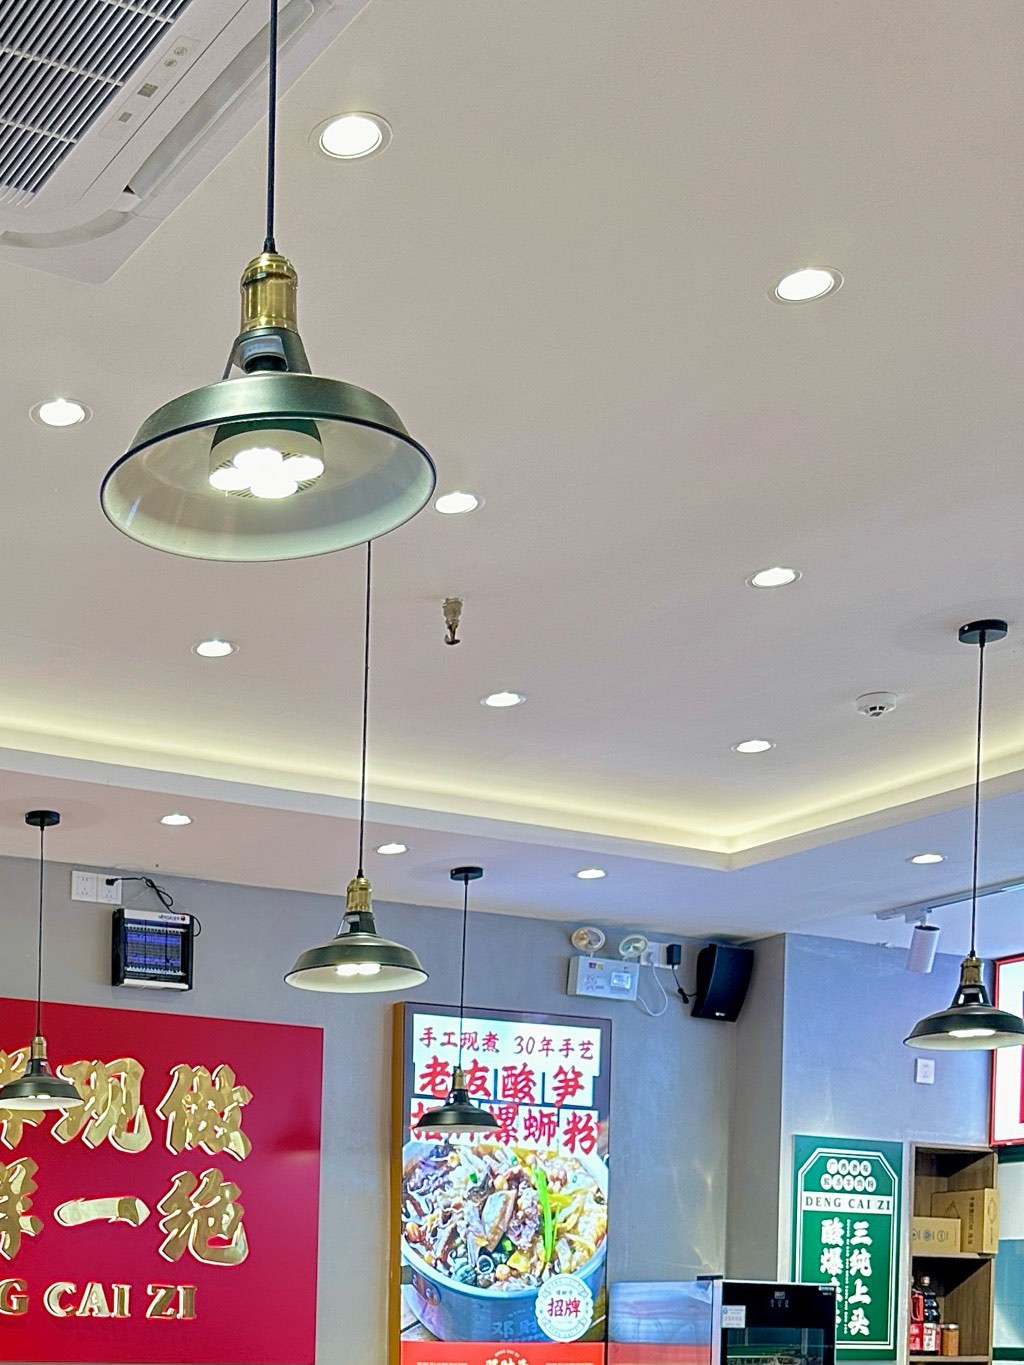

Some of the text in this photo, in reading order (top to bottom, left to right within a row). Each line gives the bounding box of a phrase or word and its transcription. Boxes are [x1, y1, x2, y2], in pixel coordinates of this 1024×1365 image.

[419, 1027, 594, 1060] 手工现煮 30年手艺
[419, 1055, 585, 1107] 老友酸笋
[805, 1196, 890, 1210] DENG CAI ZI
[848, 1220, 872, 1336] 三纯上头
[43, 1281, 132, 1319] CAI
[145, 1284, 197, 1320] ZI
[547, 1297, 581, 1318] 招牌
